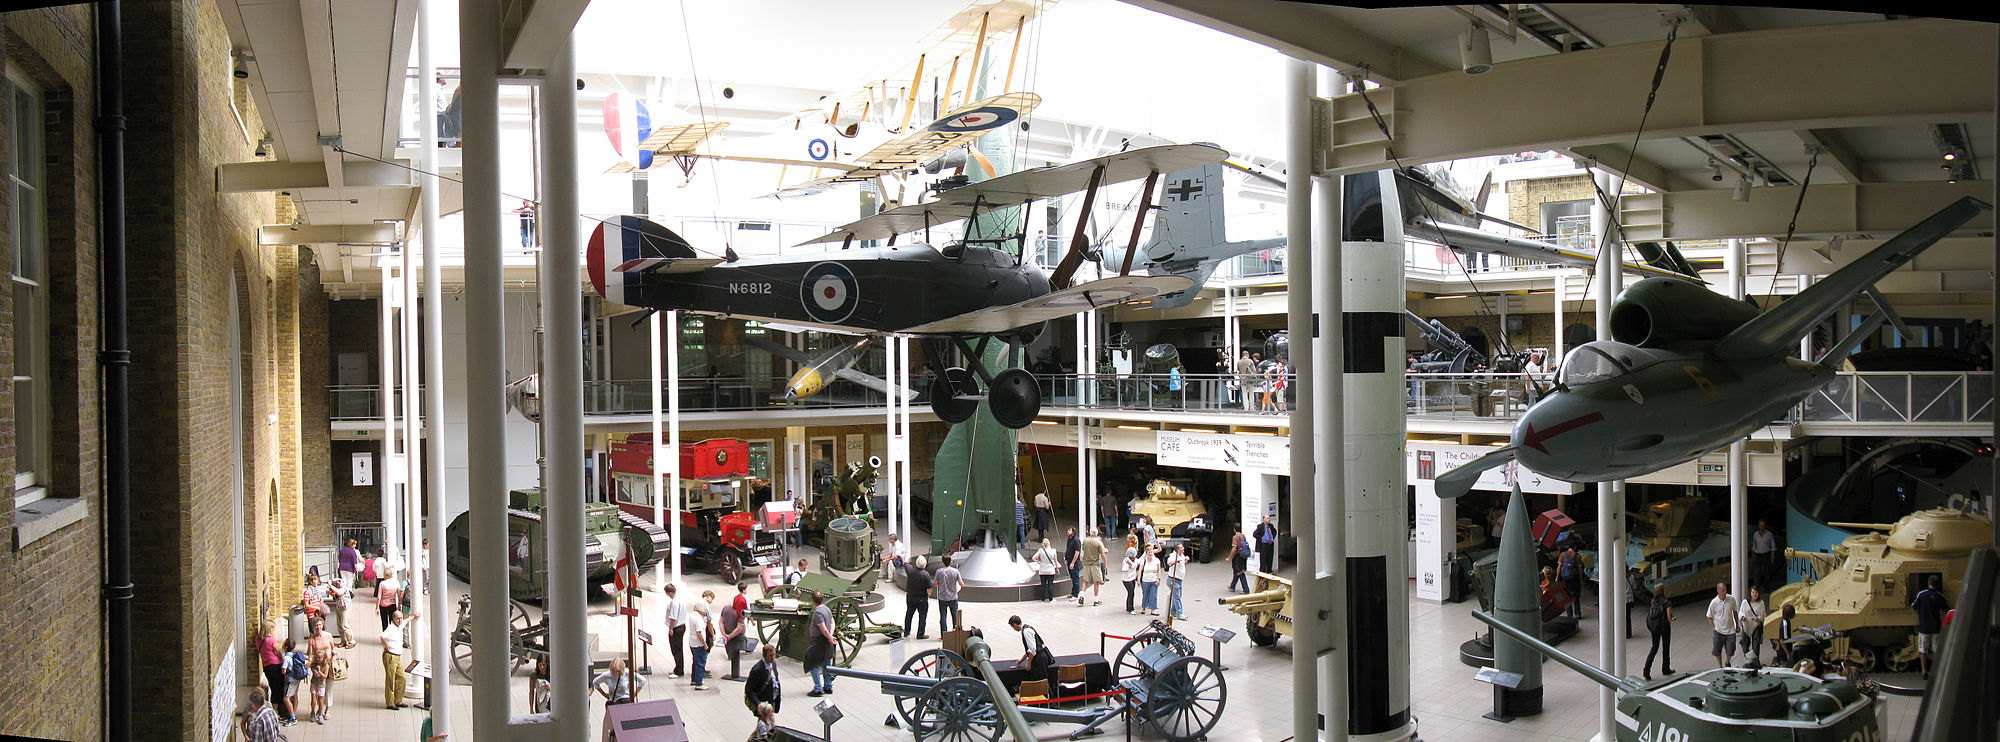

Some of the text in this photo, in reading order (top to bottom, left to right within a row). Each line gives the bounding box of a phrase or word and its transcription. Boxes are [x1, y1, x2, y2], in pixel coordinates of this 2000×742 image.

[1160, 435, 1181, 443] MUSEUM
[1187, 437, 1223, 446] Outbreak 1939
[1245, 440, 1266, 449] Terrible
[1245, 449, 1269, 459] Trenches
[1445, 451, 1458, 460] The
